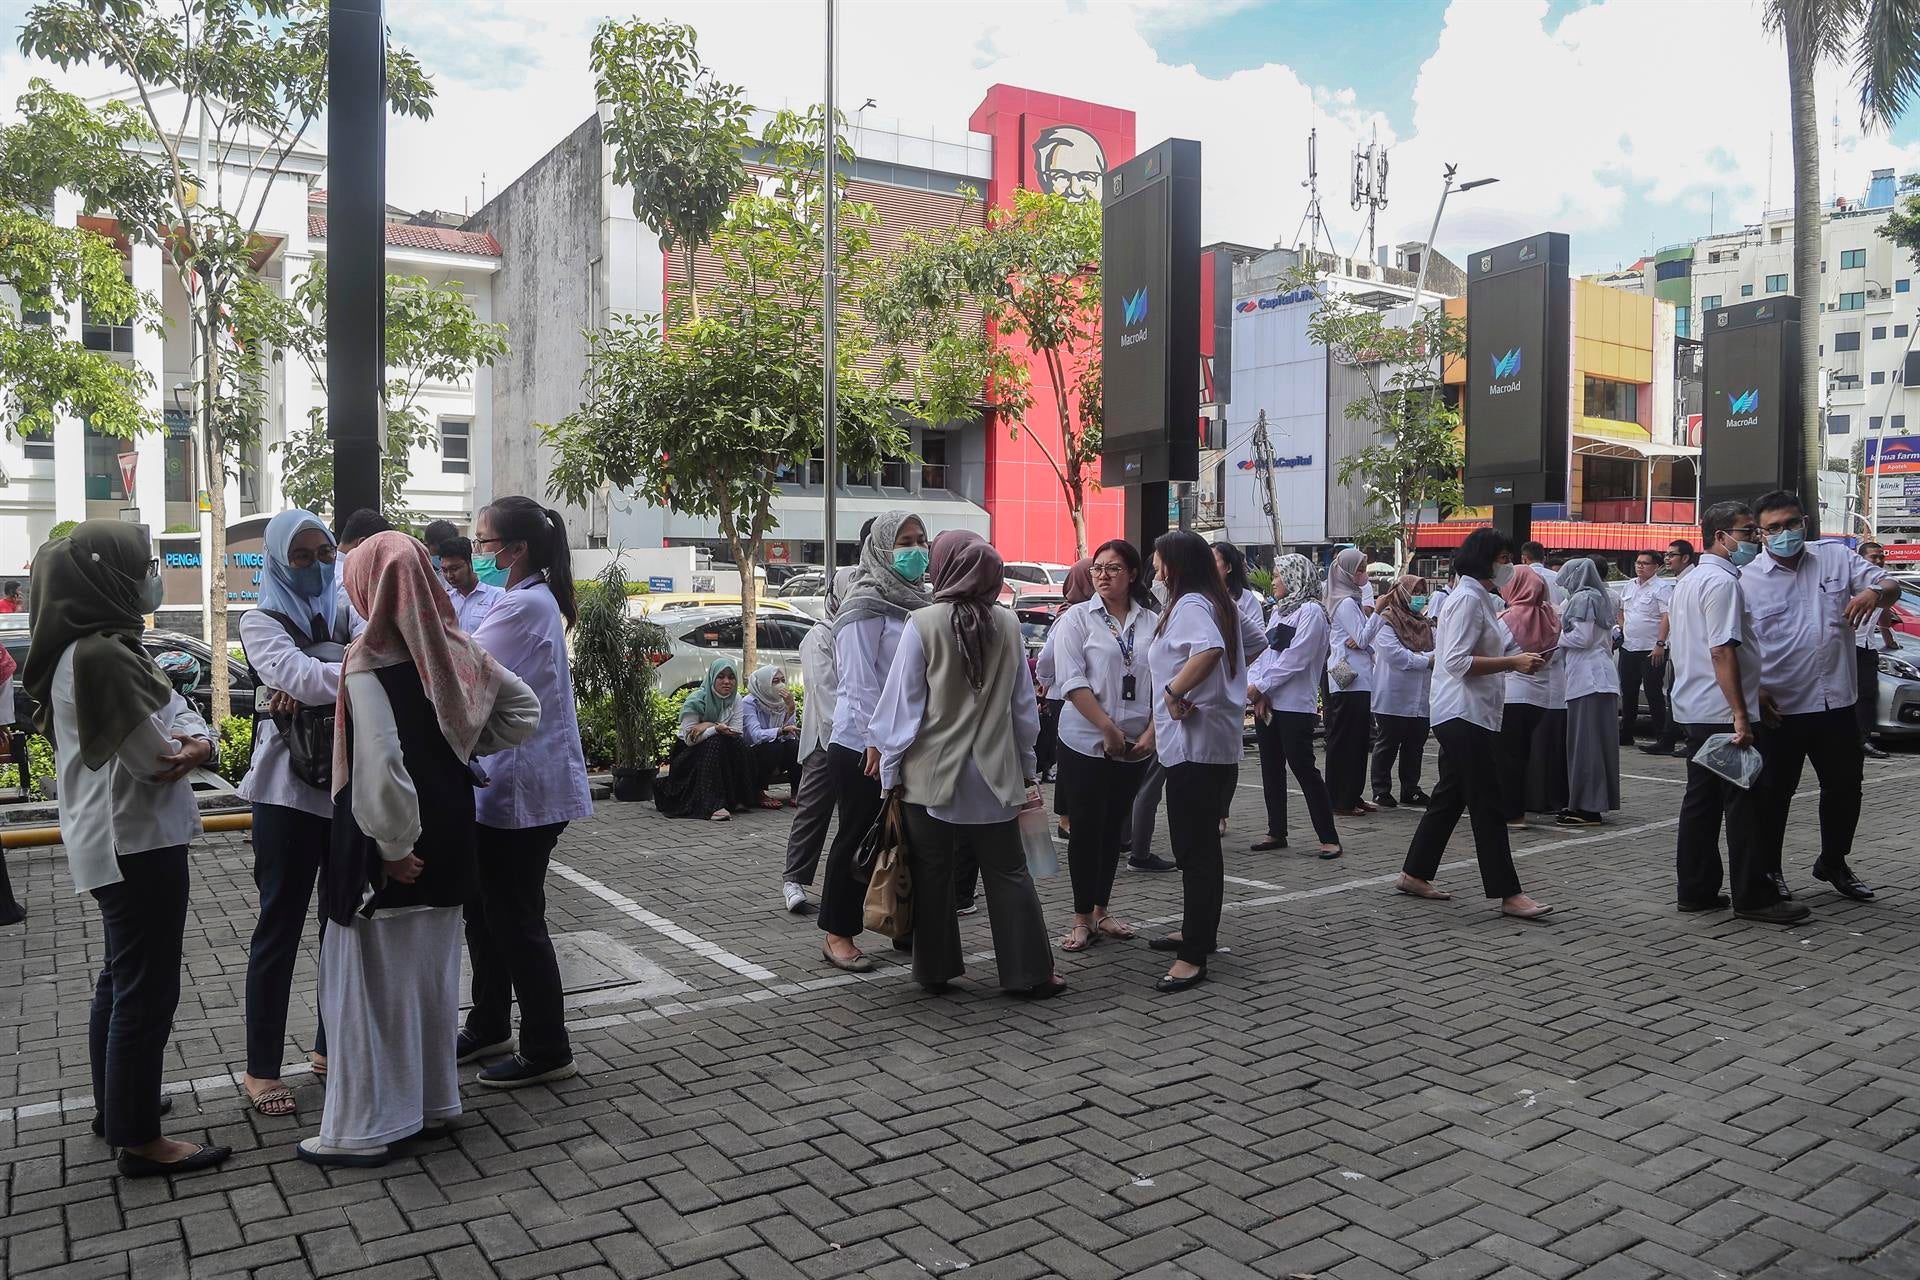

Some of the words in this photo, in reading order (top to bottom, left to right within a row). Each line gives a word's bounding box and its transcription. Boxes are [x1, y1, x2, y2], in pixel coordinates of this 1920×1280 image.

[1258, 292, 1295, 309] Capital
[1295, 290, 1314, 303] Life
[1121, 328, 1147, 347] MacroAd
[1489, 381, 1520, 395] MacroAd
[1726, 416, 1757, 428] MacroAd
[1870, 454, 1896, 462] kmia
